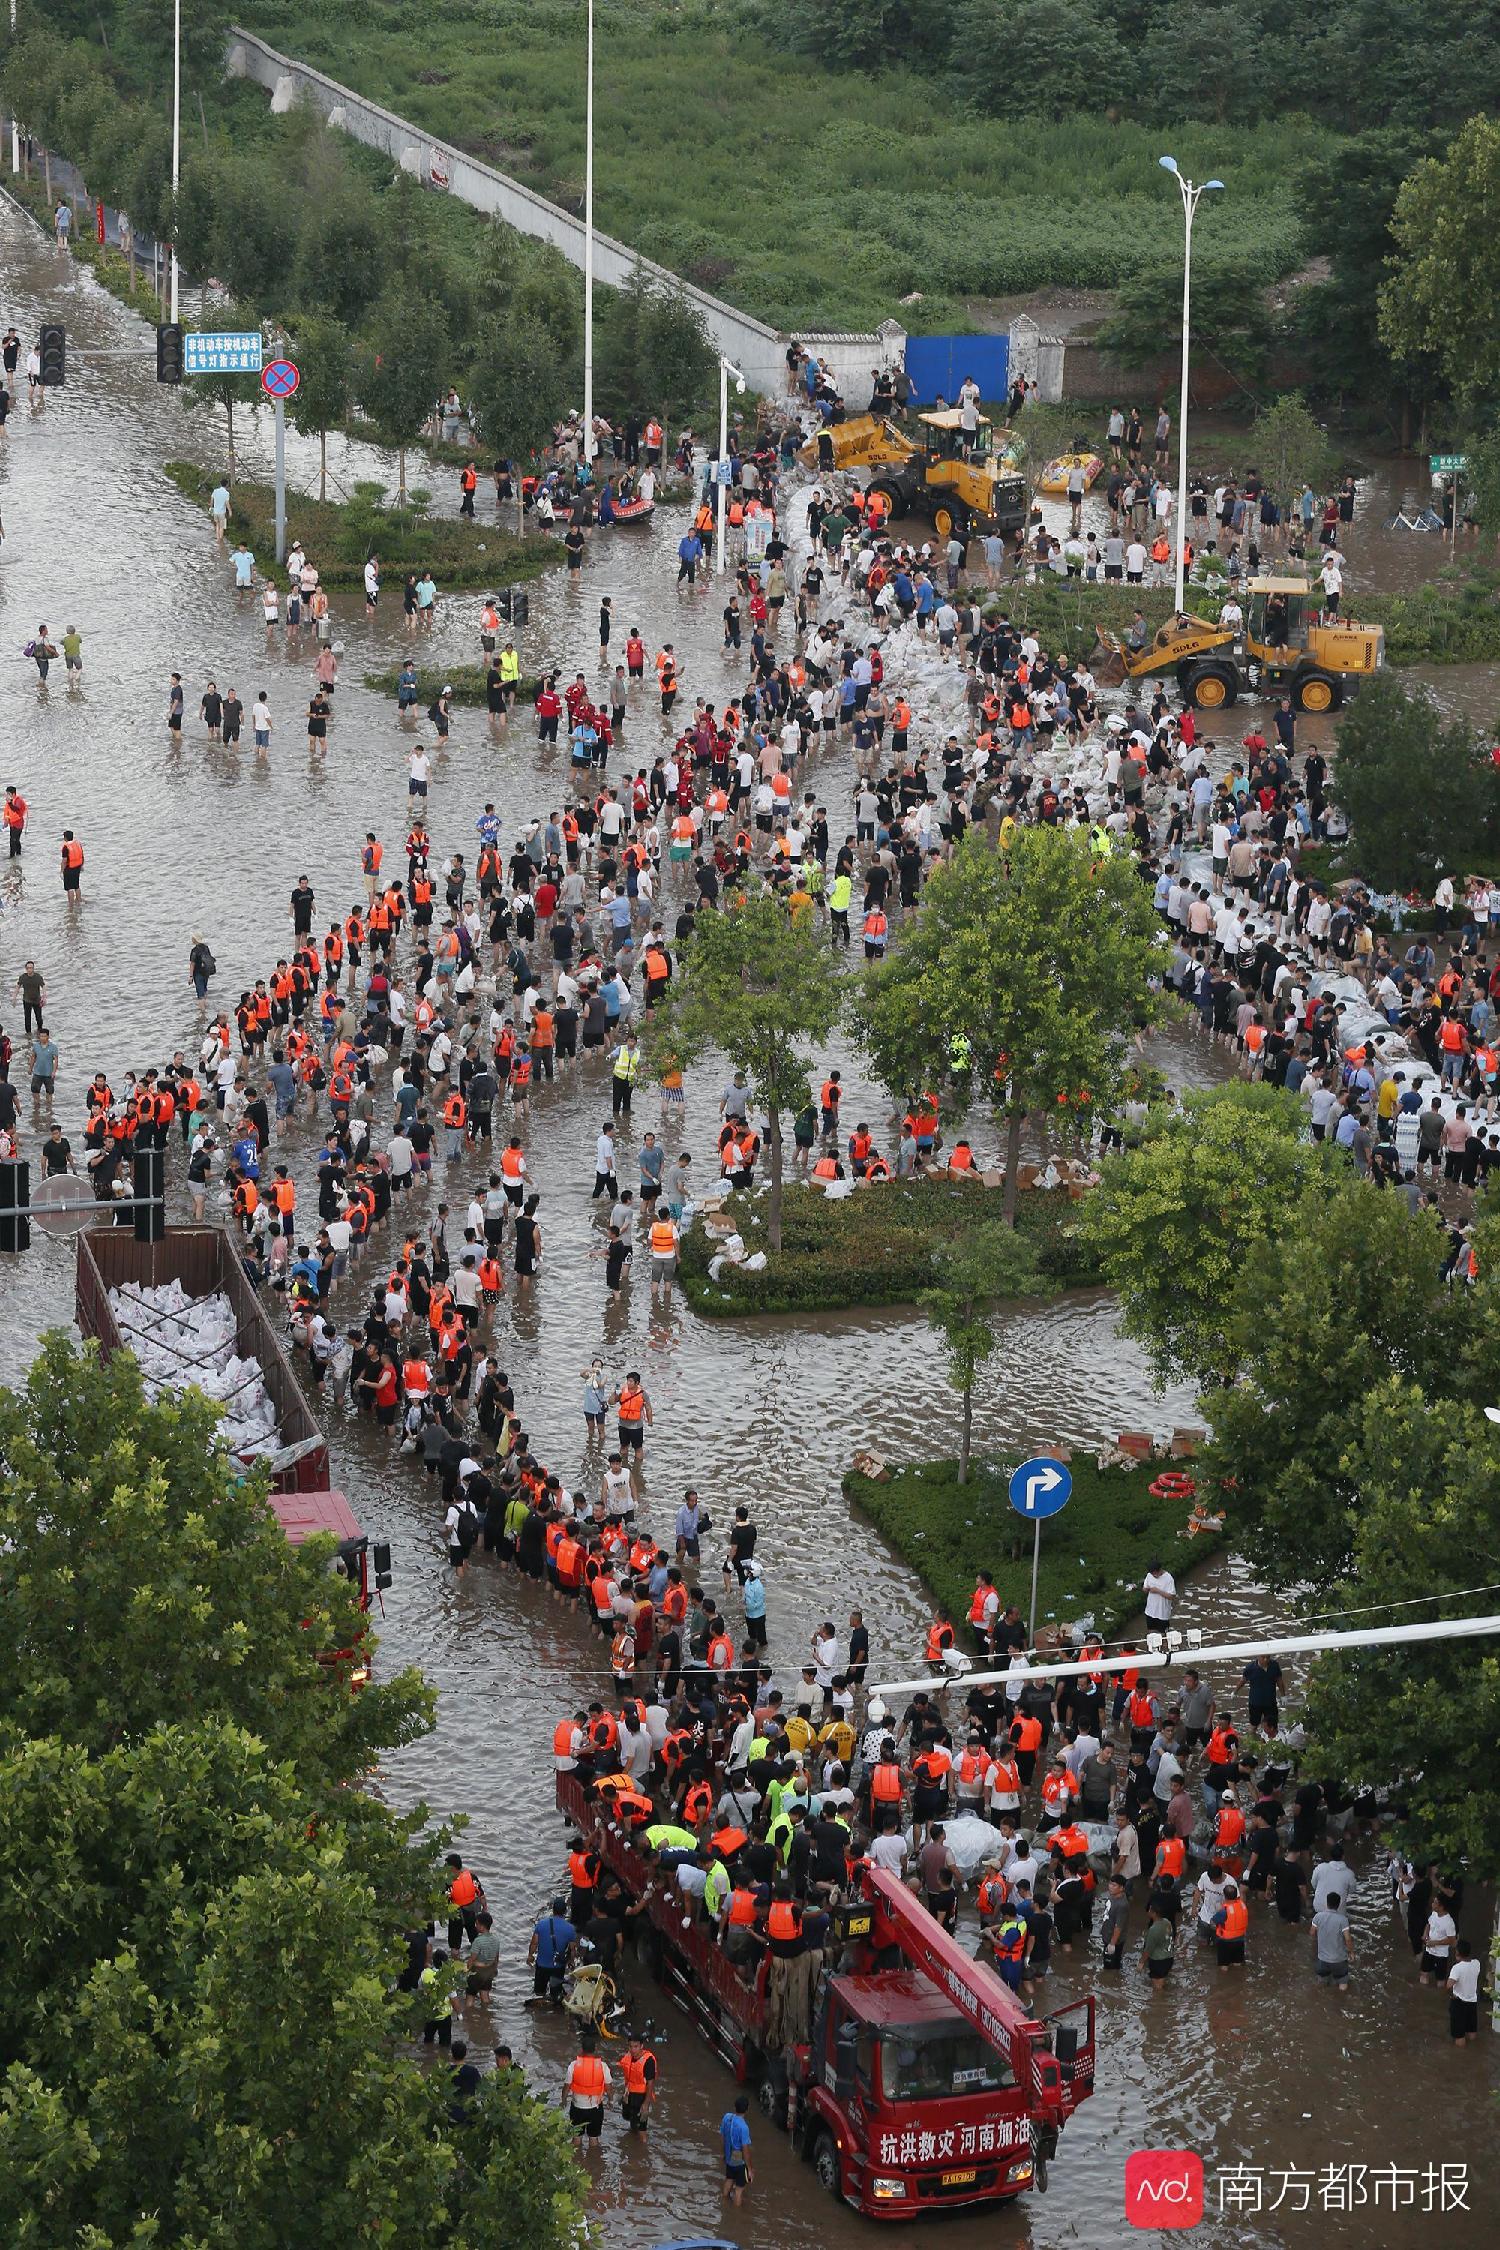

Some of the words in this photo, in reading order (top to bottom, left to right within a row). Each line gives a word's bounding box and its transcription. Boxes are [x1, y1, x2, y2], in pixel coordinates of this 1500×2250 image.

[188, 337, 259, 352] 非机动车按机动车
[188, 354, 260, 368] 信号灯指示通行
[1172, 641, 1200, 654] SDLG
[880, 2128, 954, 2164] 抗洪救灾
[960, 2113, 1031, 2155] 河南加油
